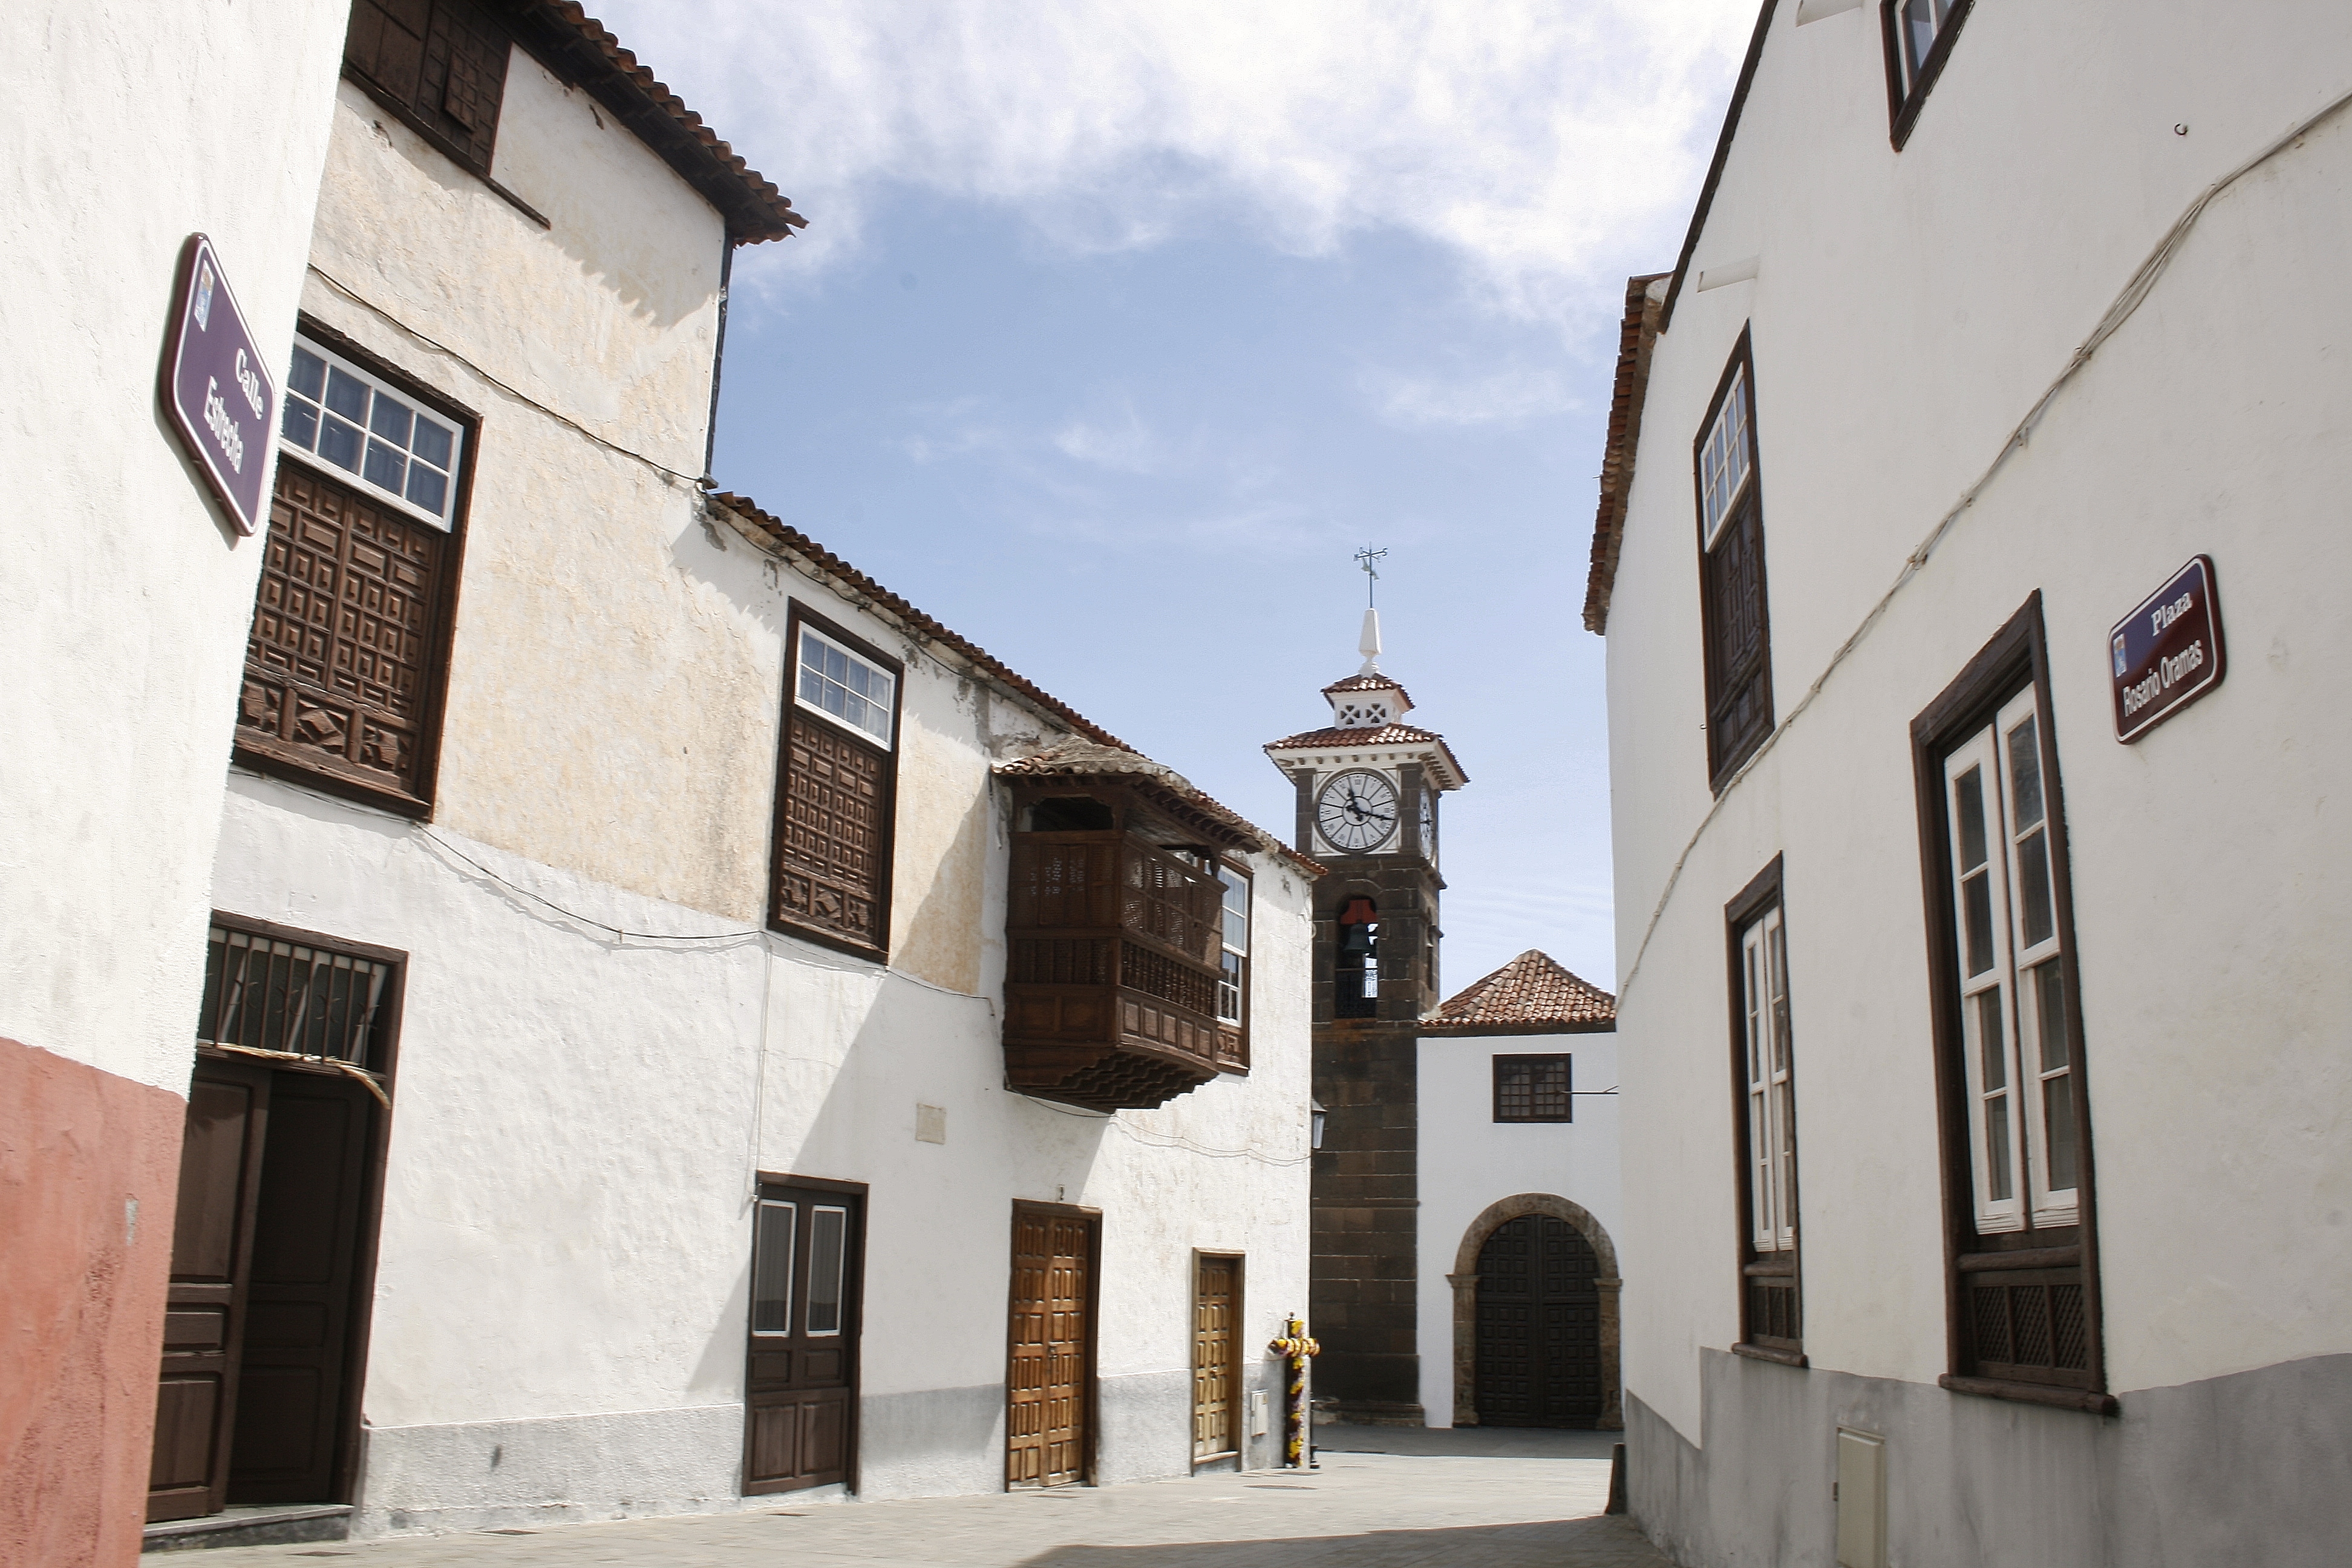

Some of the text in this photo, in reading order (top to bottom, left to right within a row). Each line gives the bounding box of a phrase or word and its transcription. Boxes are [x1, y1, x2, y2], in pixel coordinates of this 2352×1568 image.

[236, 348, 263, 420] Calle
[204, 375, 243, 474] Estrecha
[2151, 592, 2192, 636] Plaza
[2123, 639, 2203, 717] Rosario Oramas
